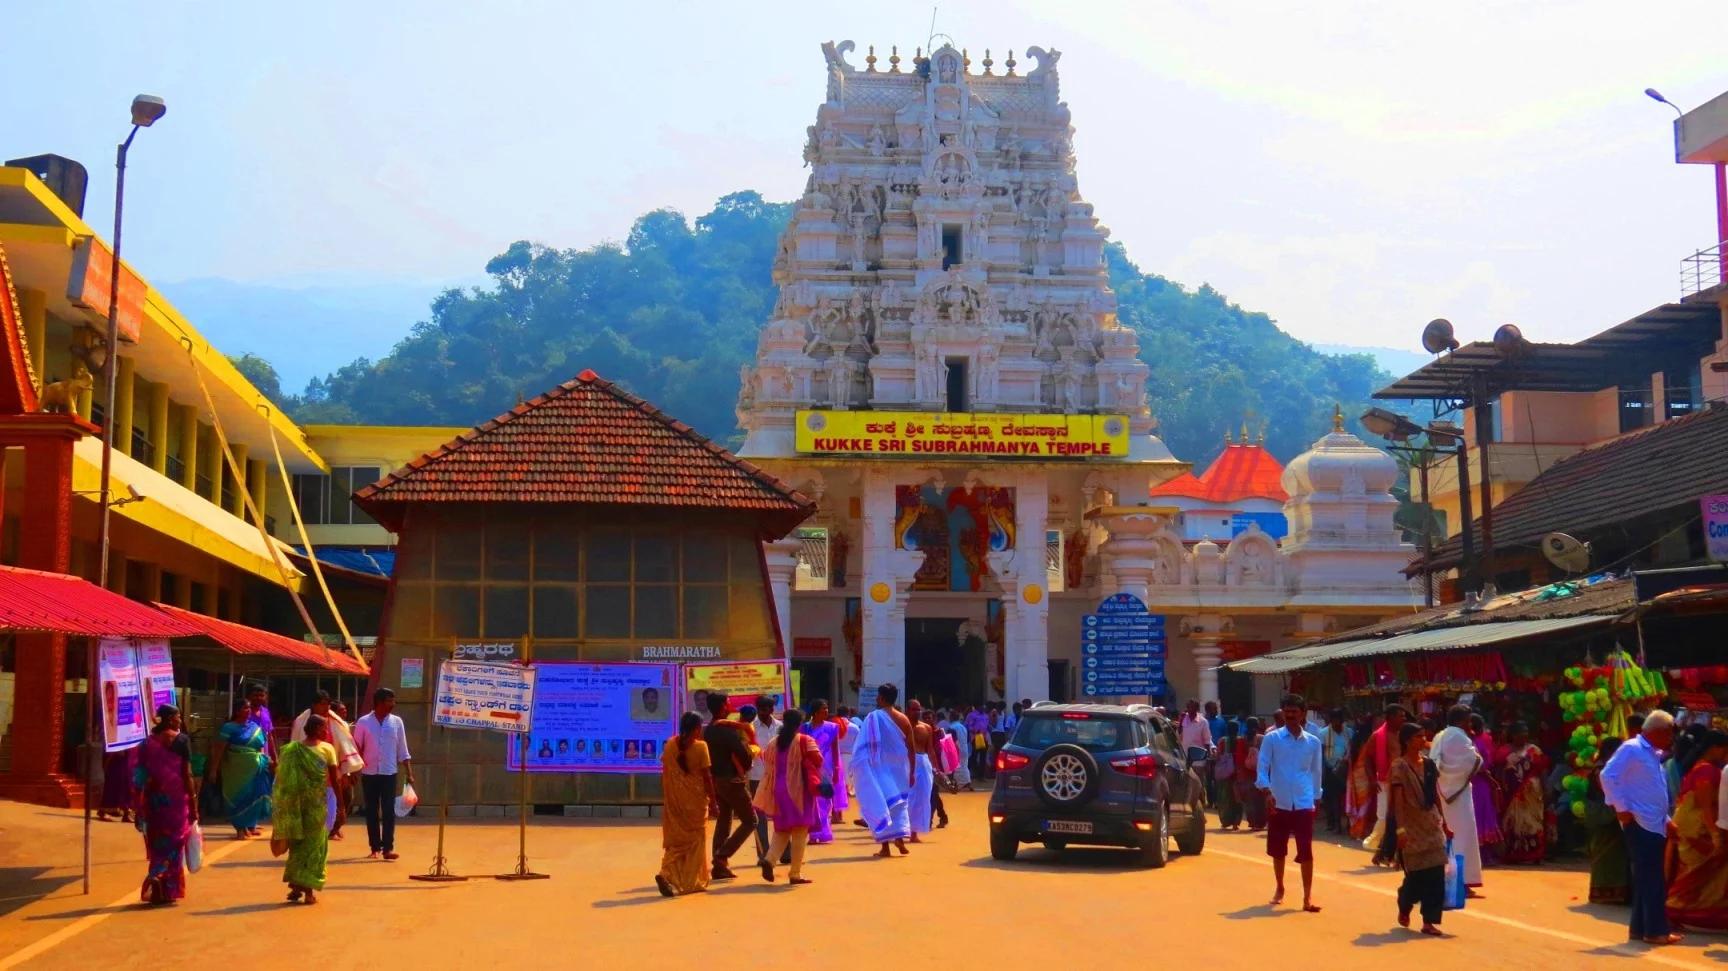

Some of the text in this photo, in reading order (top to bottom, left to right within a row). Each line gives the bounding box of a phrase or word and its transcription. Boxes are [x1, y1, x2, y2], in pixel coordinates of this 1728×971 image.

[904, 421, 925, 438] ಶ್ರೀ
[814, 438, 1111, 455] KUKKE SRI SUBRAHMANYA TEMPLE
[643, 646, 721, 658] BRAHMARATHA
[466, 718, 498, 727] CHAPPAL
[502, 722, 526, 731] STAND
